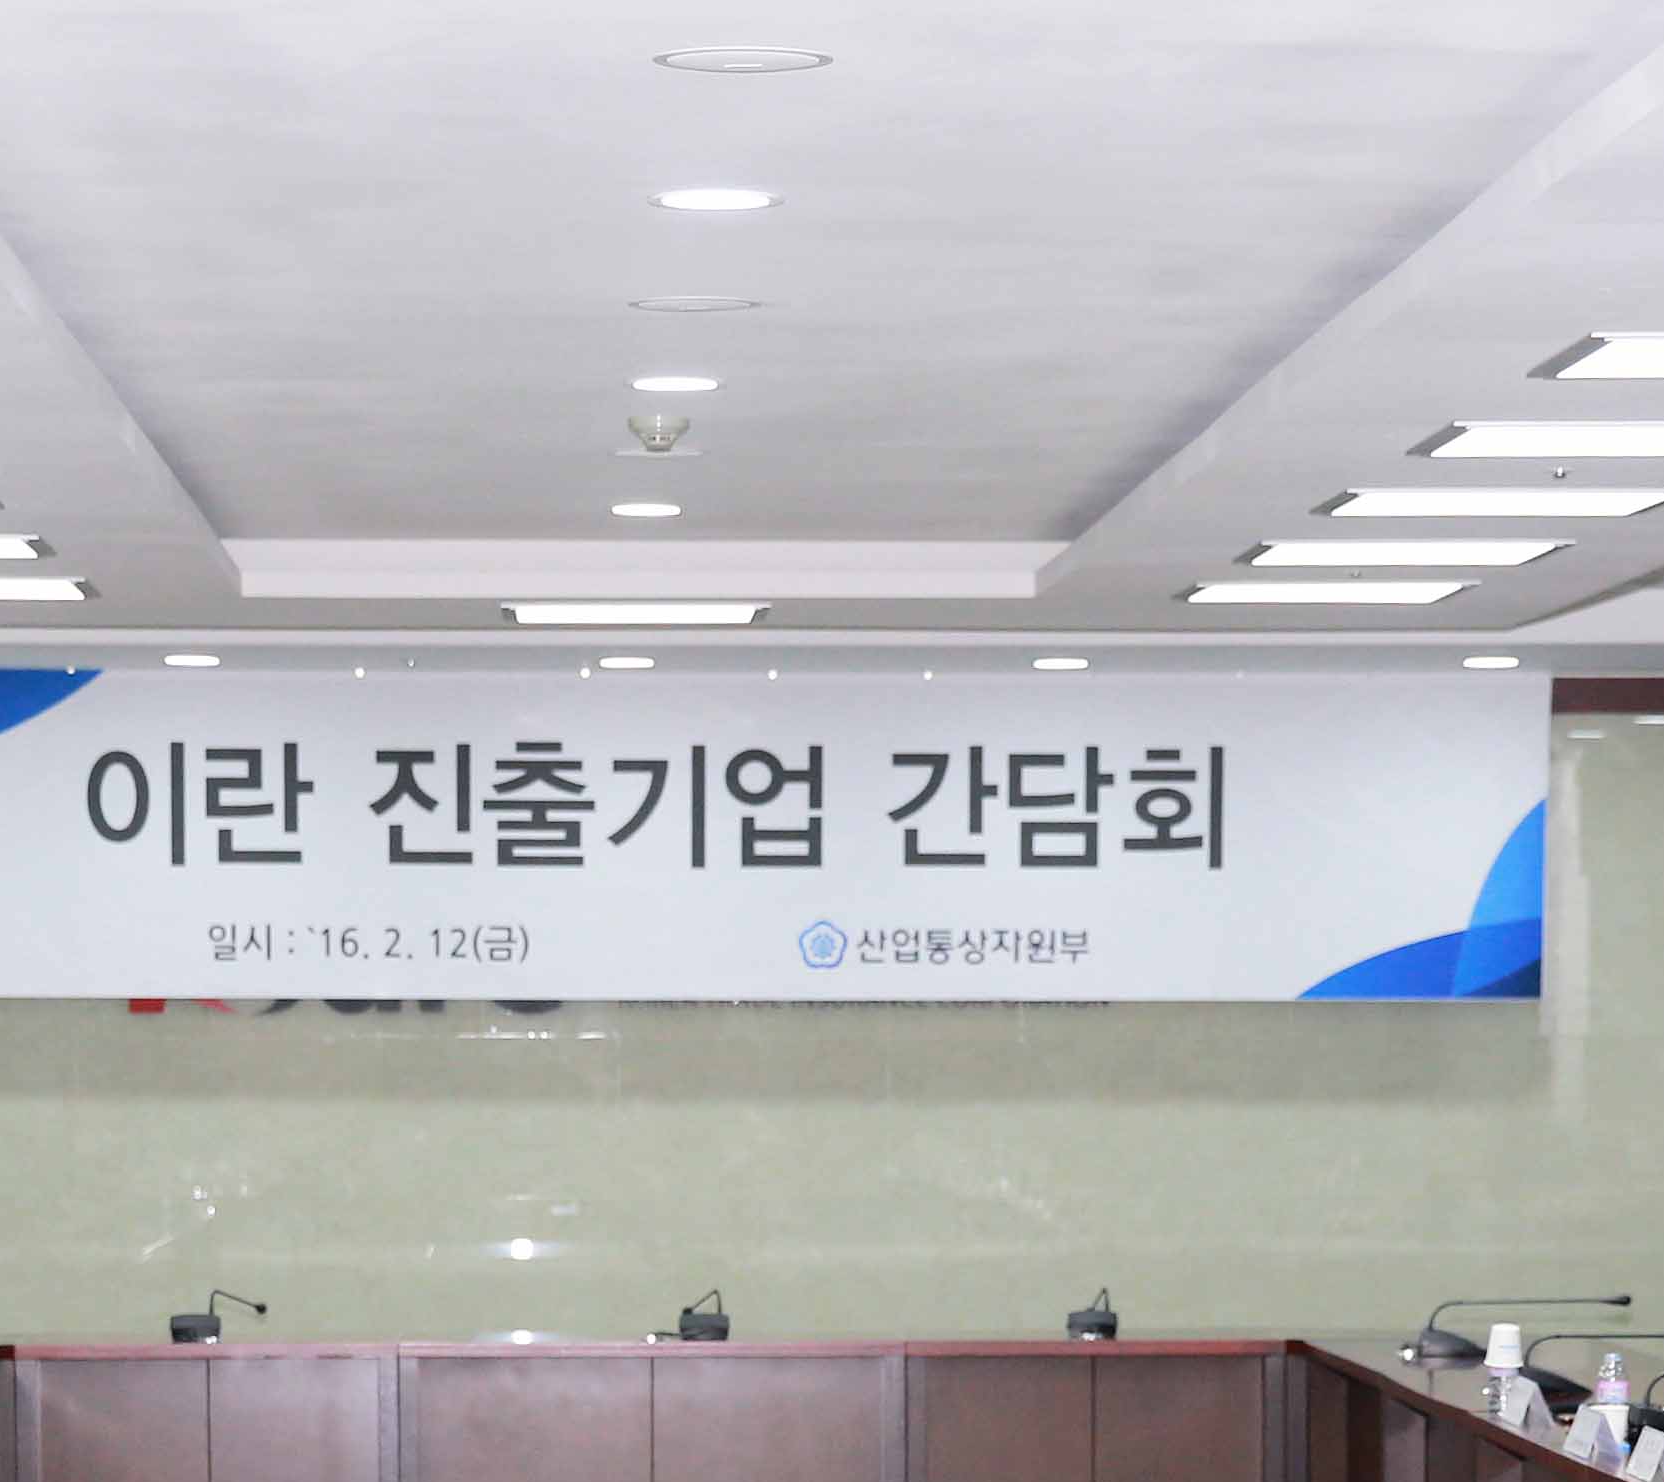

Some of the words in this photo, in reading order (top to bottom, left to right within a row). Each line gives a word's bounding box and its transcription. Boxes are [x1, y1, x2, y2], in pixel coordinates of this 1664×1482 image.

[85, 741, 314, 866] 이란
[366, 741, 826, 868] 진출기업
[886, 745, 1228, 870] 간담회
[208, 923, 271, 961] 일시
[384, 927, 414, 960] 2.
[432, 924, 530, 963] 12(금)
[856, 928, 1090, 966] 산업통상자원부
